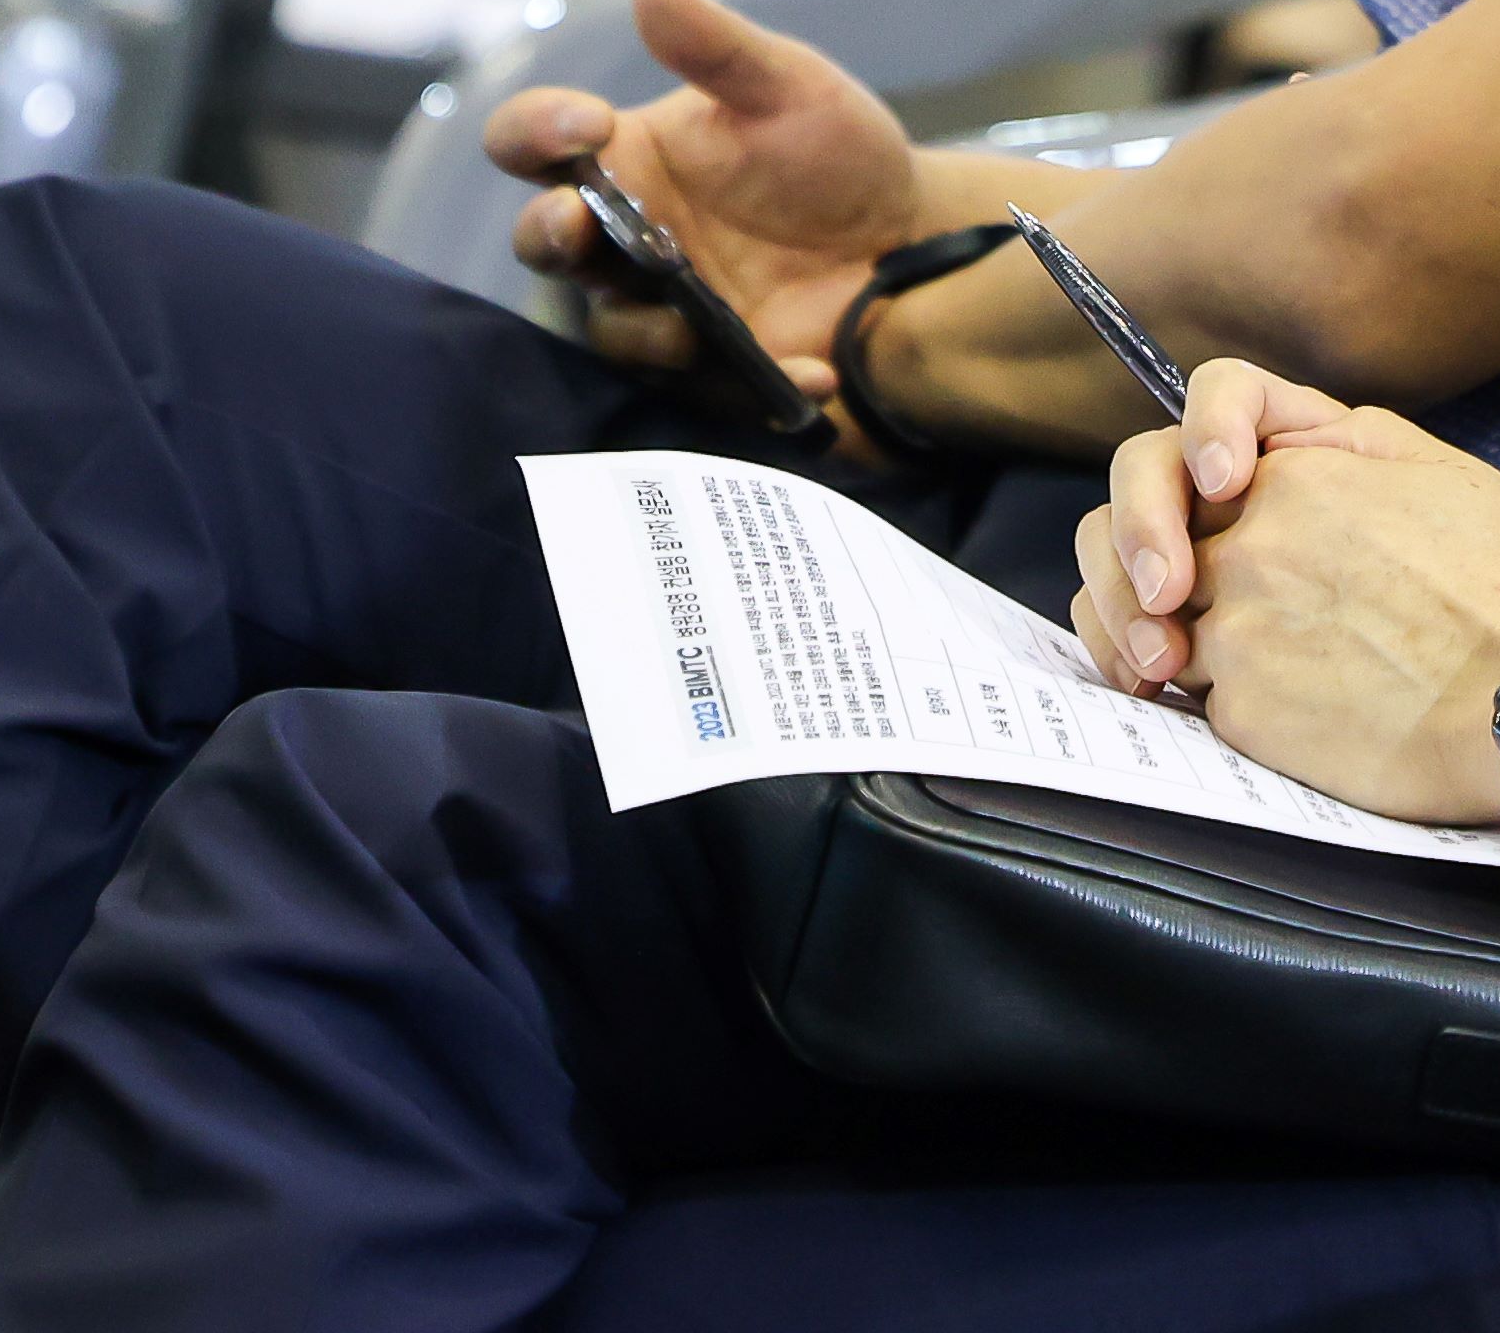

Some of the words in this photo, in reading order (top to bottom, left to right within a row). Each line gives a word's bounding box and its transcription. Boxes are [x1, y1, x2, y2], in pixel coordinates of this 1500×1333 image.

[632, 481, 672, 516] 설문조사
[644, 520, 682, 551] 참가자
[655, 556, 692, 588] 컨설팅
[665, 593, 706, 638] 병원경영
[677, 647, 714, 699] BIMTC
[692, 702, 725, 741] 2023
